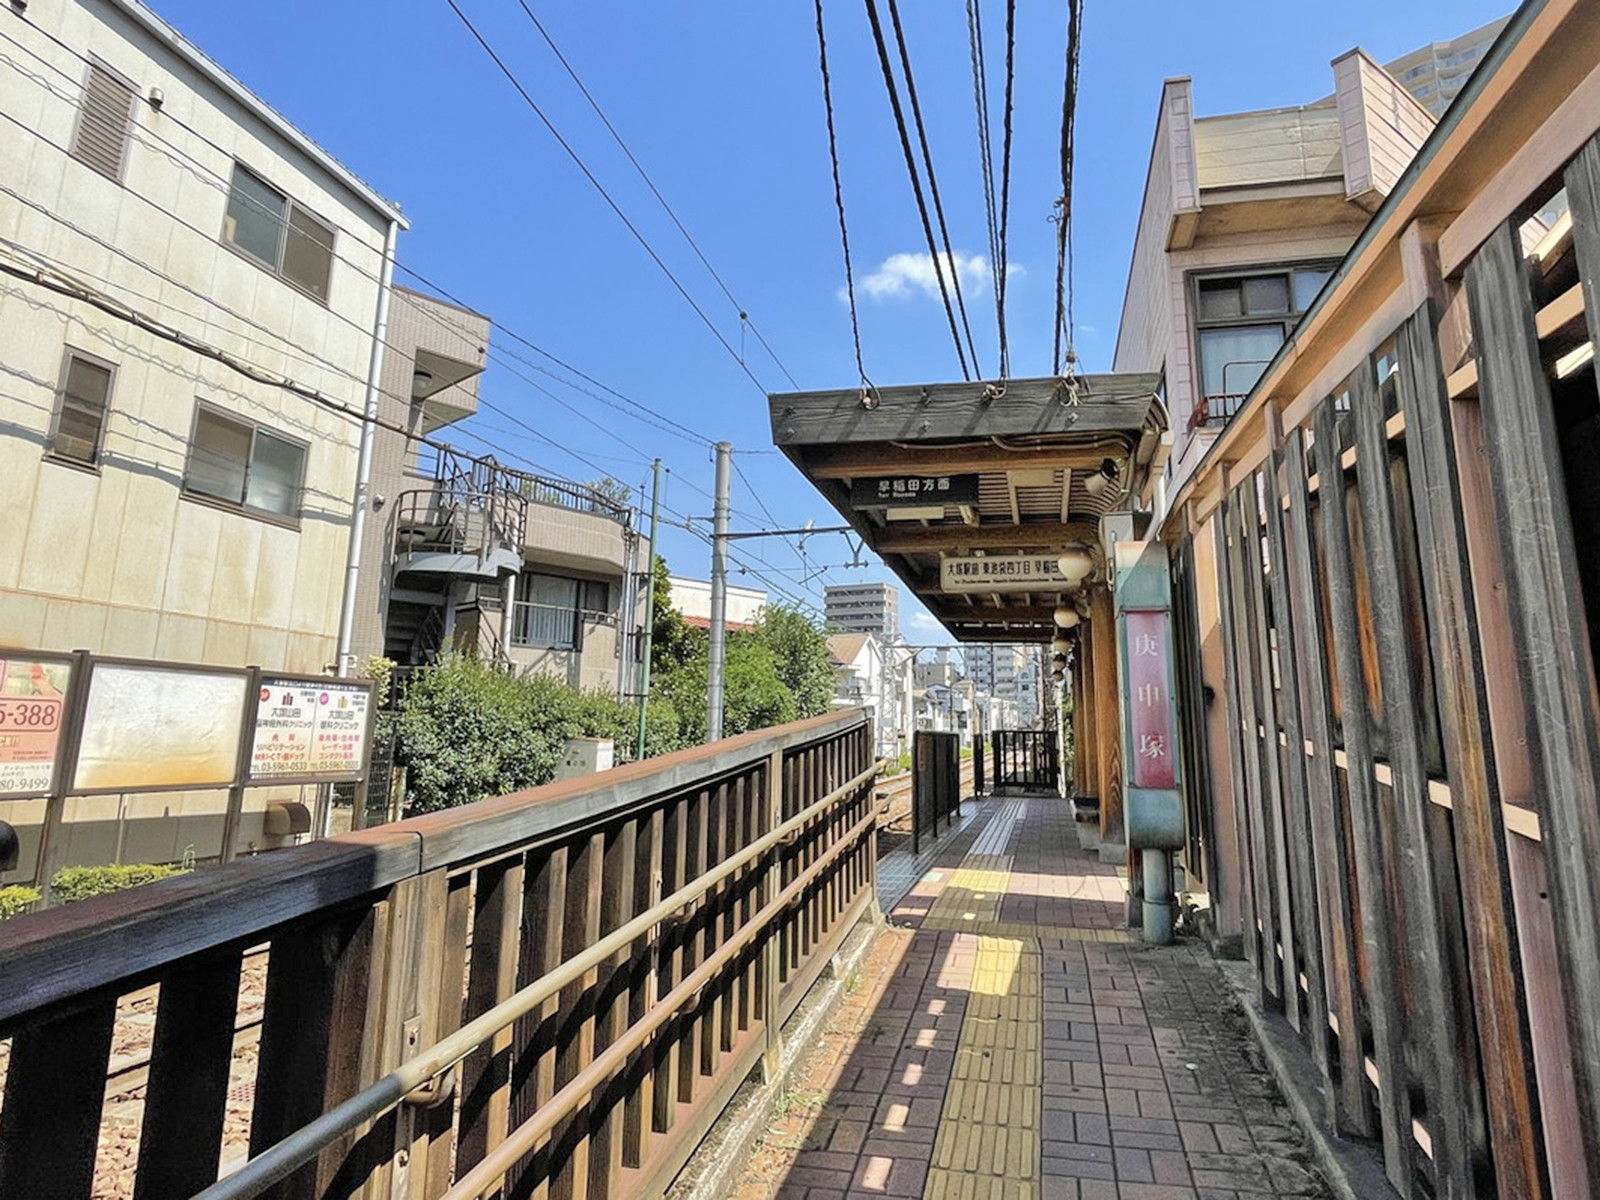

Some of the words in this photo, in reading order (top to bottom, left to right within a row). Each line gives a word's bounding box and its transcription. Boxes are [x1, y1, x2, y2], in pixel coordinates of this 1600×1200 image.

[878, 477, 950, 492] 早稲田方面
[947, 562, 979, 576] 大塚駅前
[983, 560, 1030, 575] 東池袋四丁目
[1035, 560, 1059, 573] 早稲田
[1134, 633, 1165, 758] 庚申塚
